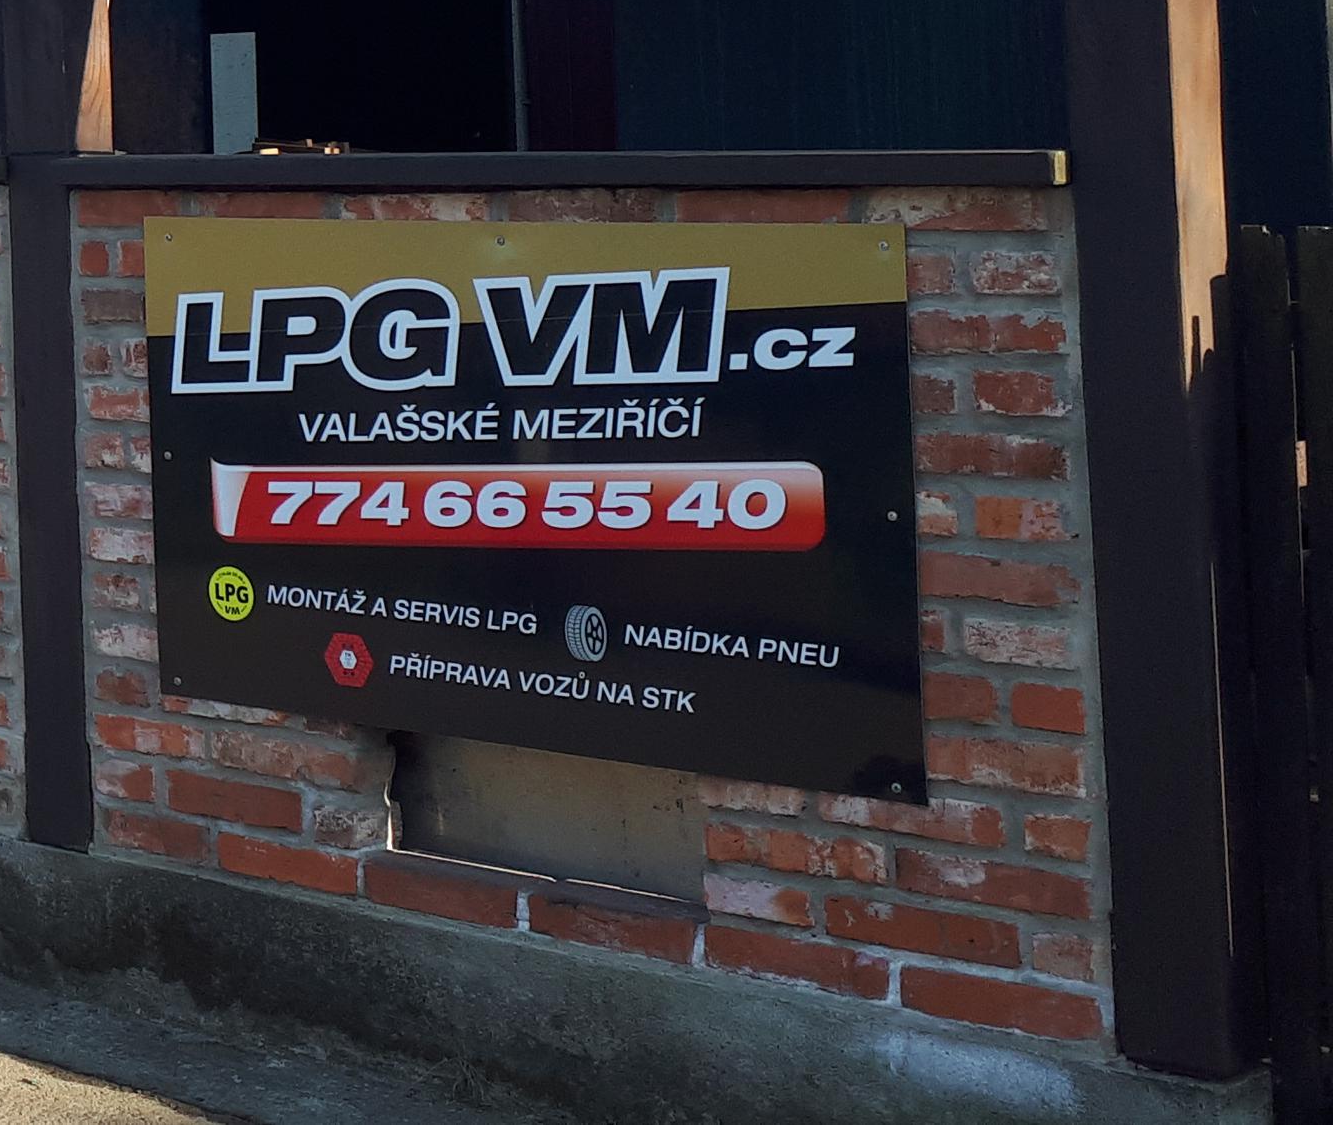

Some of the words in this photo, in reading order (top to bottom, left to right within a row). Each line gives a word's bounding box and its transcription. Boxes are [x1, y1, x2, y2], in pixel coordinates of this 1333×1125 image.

[170, 279, 460, 394] LPG
[298, 403, 500, 444] VALAŠSKÉ
[513, 397, 706, 441] MEZIŘÍČÍ
[267, 481, 410, 527] 774
[423, 480, 527, 528] 66
[541, 481, 652, 529] 55
[666, 478, 788, 529] 40
[214, 583, 249, 604] LPG
[266, 584, 367, 615] MONTÁŽ
[371, 597, 388, 617] A
[393, 598, 481, 628] SERVIS
[487, 609, 538, 635] LPG
[624, 624, 750, 659] NABÍDKA
[757, 638, 840, 668] PNEU
[389, 652, 511, 690] PŘÍPRAVA
[518, 670, 590, 700] VOZŮ
[596, 680, 635, 706] NA
[641, 686, 697, 713] STK
